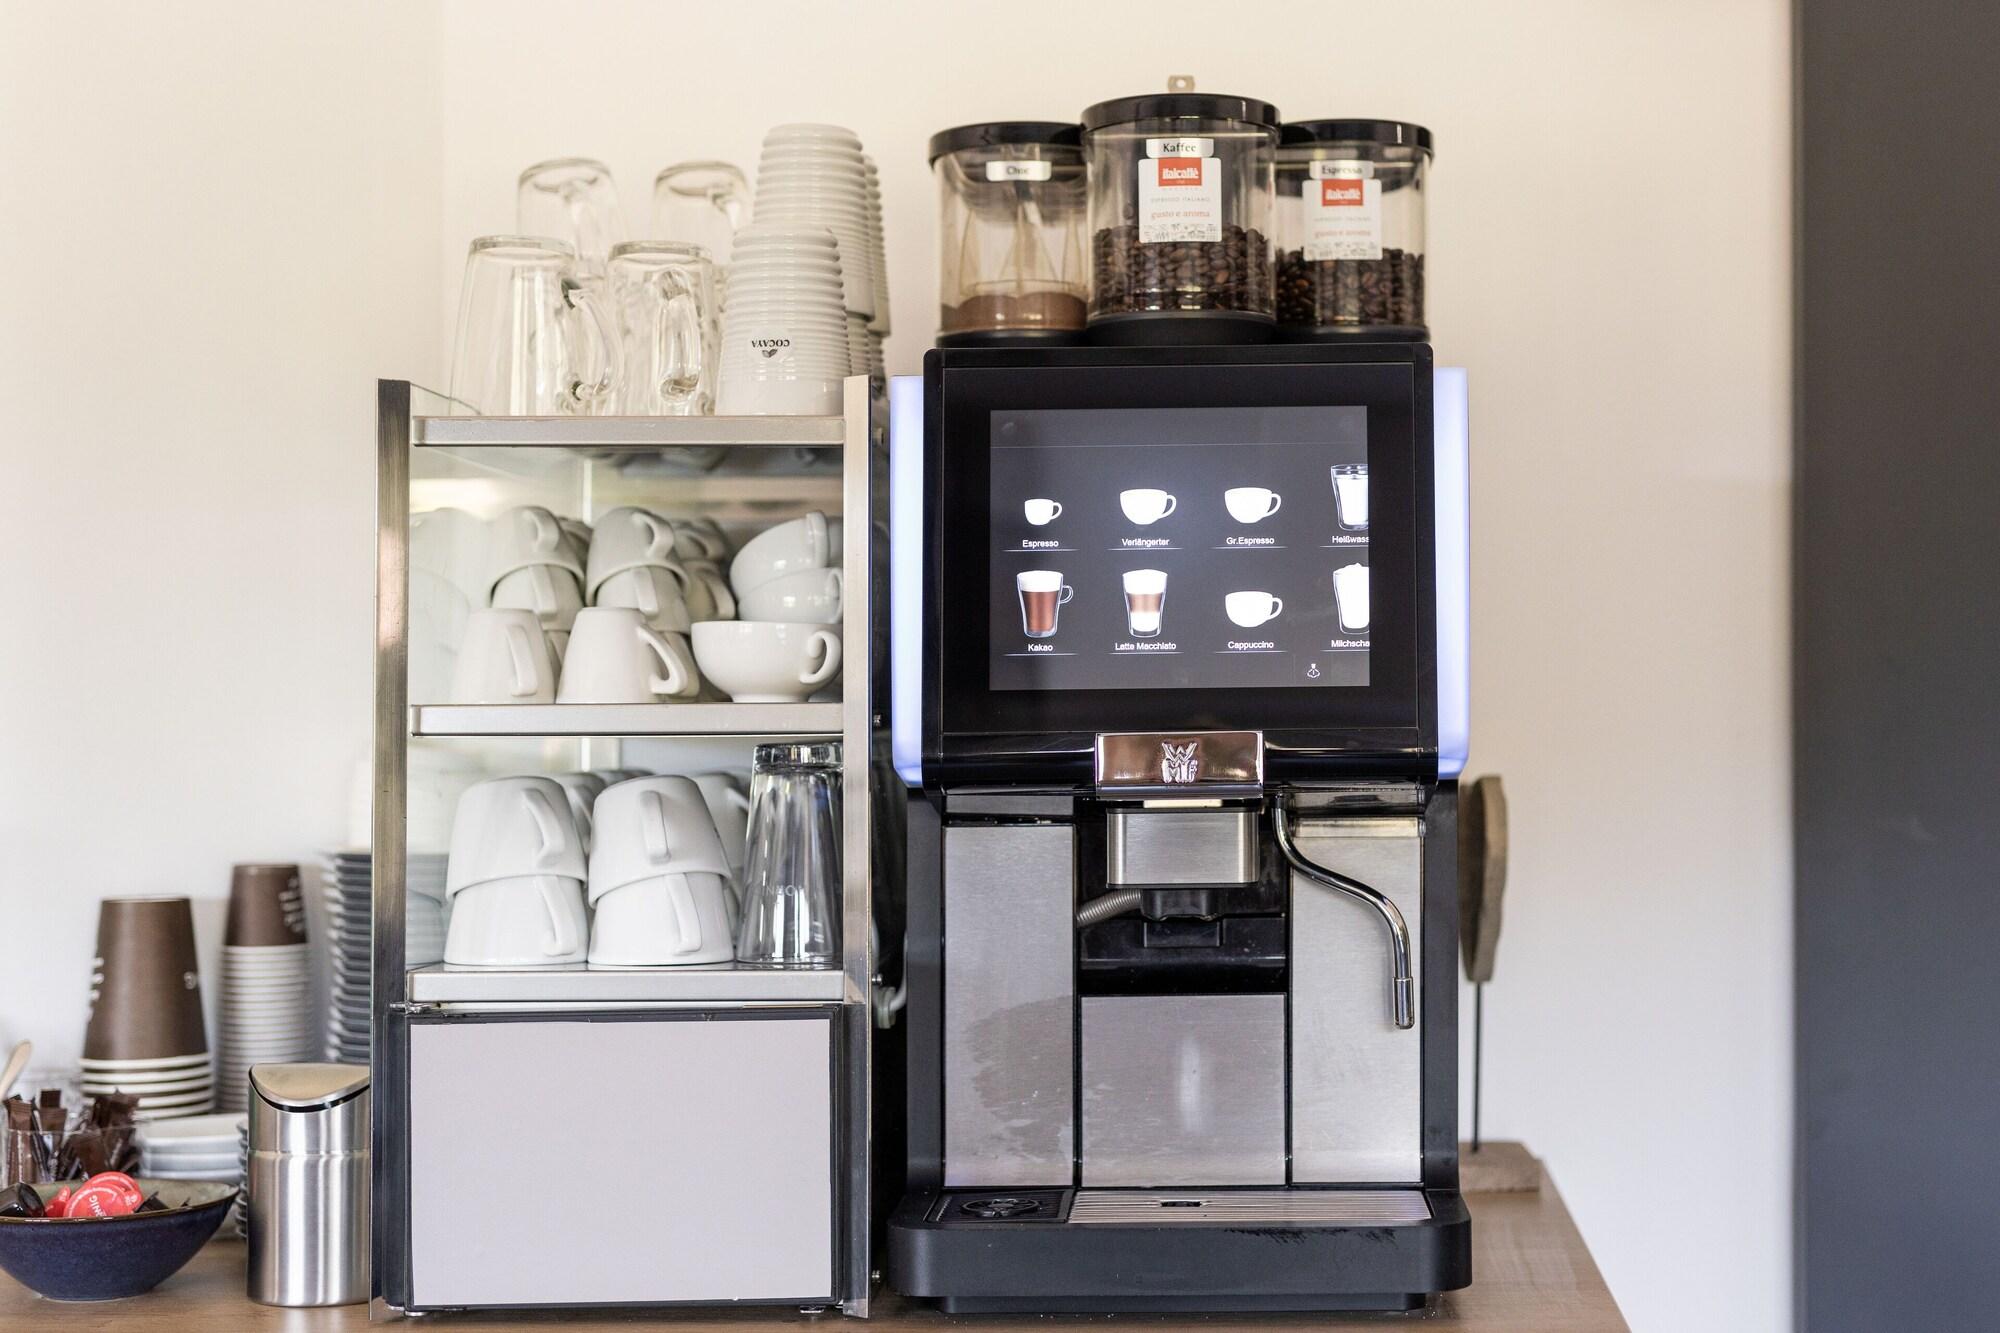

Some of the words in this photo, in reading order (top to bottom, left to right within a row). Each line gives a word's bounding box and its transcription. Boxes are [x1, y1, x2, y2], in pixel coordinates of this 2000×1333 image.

[1163, 143, 1197, 153] Kaffee
[1321, 165, 1363, 175] Espresso
[751, 339, 790, 348] COCAYA
[1022, 539, 1059, 549] Espresso
[1121, 538, 1170, 548] Verlängerter
[1226, 537, 1275, 546] Gr.Espresso
[1028, 643, 1054, 652] Kakao
[1115, 642, 1135, 651] Latte
[1136, 642, 1177, 651] Macchiato
[1227, 641, 1274, 650] Cappuccino
